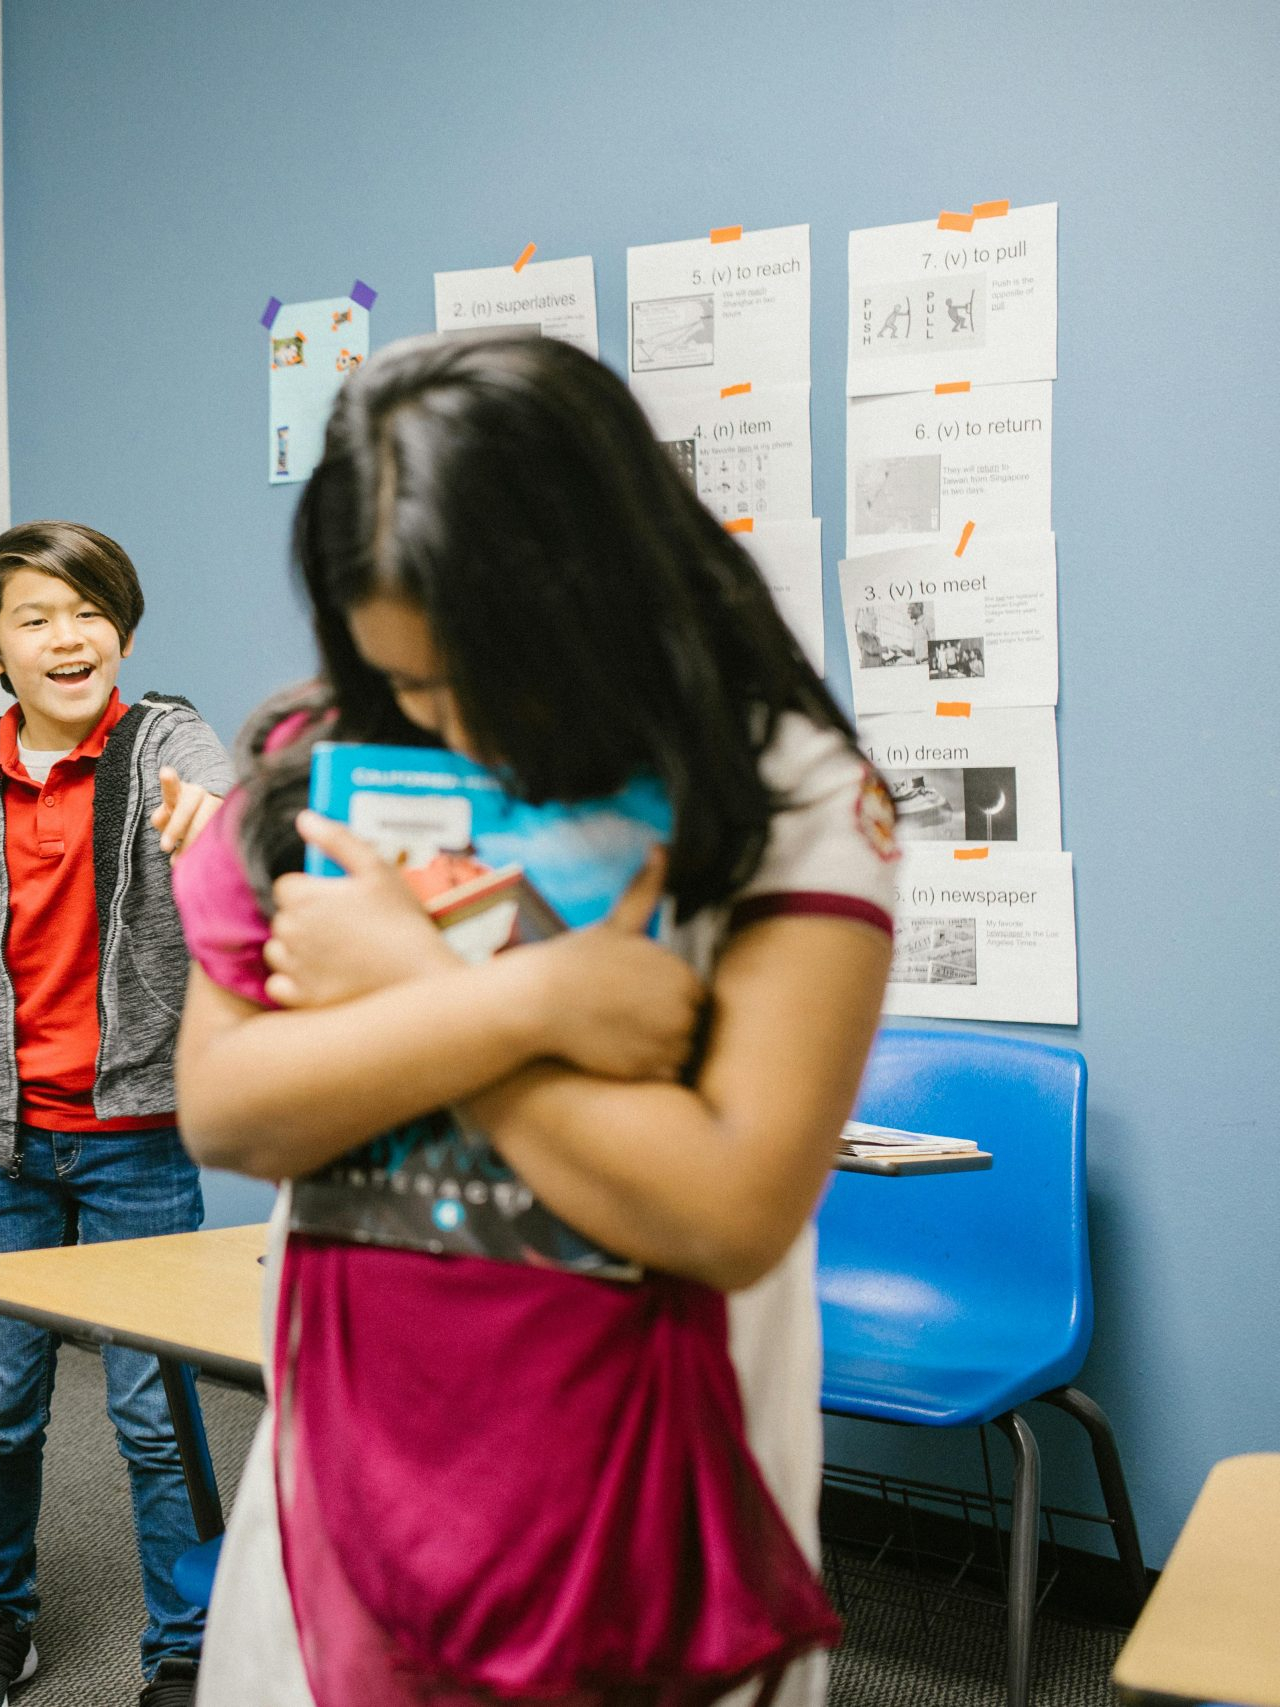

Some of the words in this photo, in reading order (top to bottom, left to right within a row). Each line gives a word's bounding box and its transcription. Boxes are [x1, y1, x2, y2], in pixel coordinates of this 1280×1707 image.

[922, 252, 938, 270] 7.
[944, 248, 968, 271] (v)
[973, 247, 990, 263] to
[996, 239, 1027, 264] pull
[692, 269, 707, 286] 5.
[711, 265, 733, 286] (v)
[736, 265, 751, 280] to
[756, 257, 801, 277] reach
[991, 279, 1012, 288] Push
[1022, 275, 1035, 285] the
[991, 287, 1025, 301] opposite
[453, 301, 467, 318] 2.
[471, 299, 492, 319] (n)
[495, 292, 577, 315] superlatives
[926, 291, 935, 340] PULL
[862, 298, 872, 345] PUSH
[692, 423, 708, 439] 4.
[713, 421, 735, 442] (n)
[738, 419, 772, 435] item
[915, 423, 931, 441] 6.
[937, 420, 960, 442] (v)
[966, 420, 982, 436] to
[988, 417, 1043, 435] return
[711, 445, 736, 455] favorite
[942, 466, 960, 476] They
[976, 463, 1000, 474] return
[942, 475, 969, 485] Taiwan
[969, 474, 988, 484] from
[989, 472, 1030, 484] Singapore
[950, 487, 965, 496] two
[864, 584, 882, 601] 3.
[888, 580, 914, 602] (v)
[919, 579, 937, 595] to
[943, 574, 988, 593] meet
[886, 745, 910, 765] (n)
[914, 744, 970, 761] dream
[911, 885, 936, 907] (n)
[940, 888, 1038, 907] newspaper
[986, 919, 997, 928] My
[997, 919, 1024, 927] favorite
[986, 930, 1024, 938] newspaper
[986, 938, 1015, 947] Angeles
